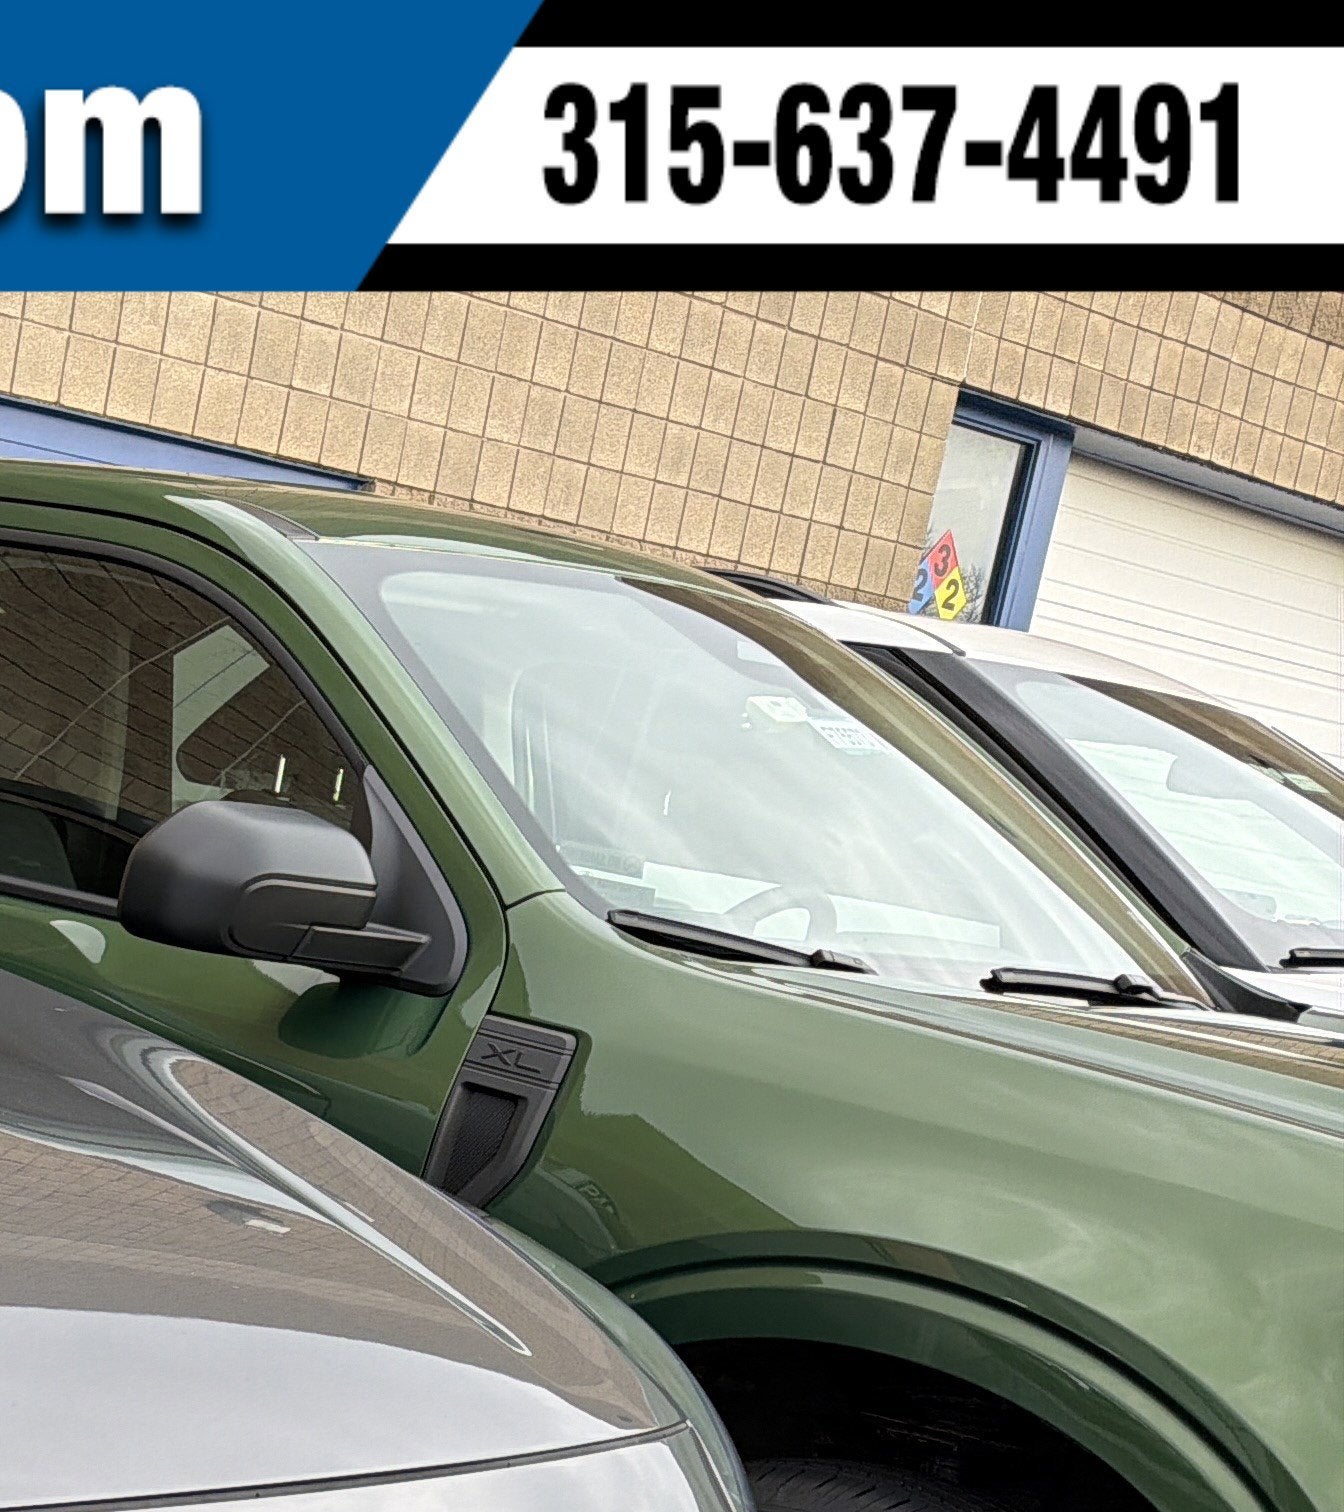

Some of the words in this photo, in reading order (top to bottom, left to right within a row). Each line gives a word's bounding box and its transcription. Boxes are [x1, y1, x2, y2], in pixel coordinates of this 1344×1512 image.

[933, 543, 952, 577] 3
[911, 567, 929, 602] 2
[941, 577, 960, 611] 2
[480, 1042, 542, 1075] XL
